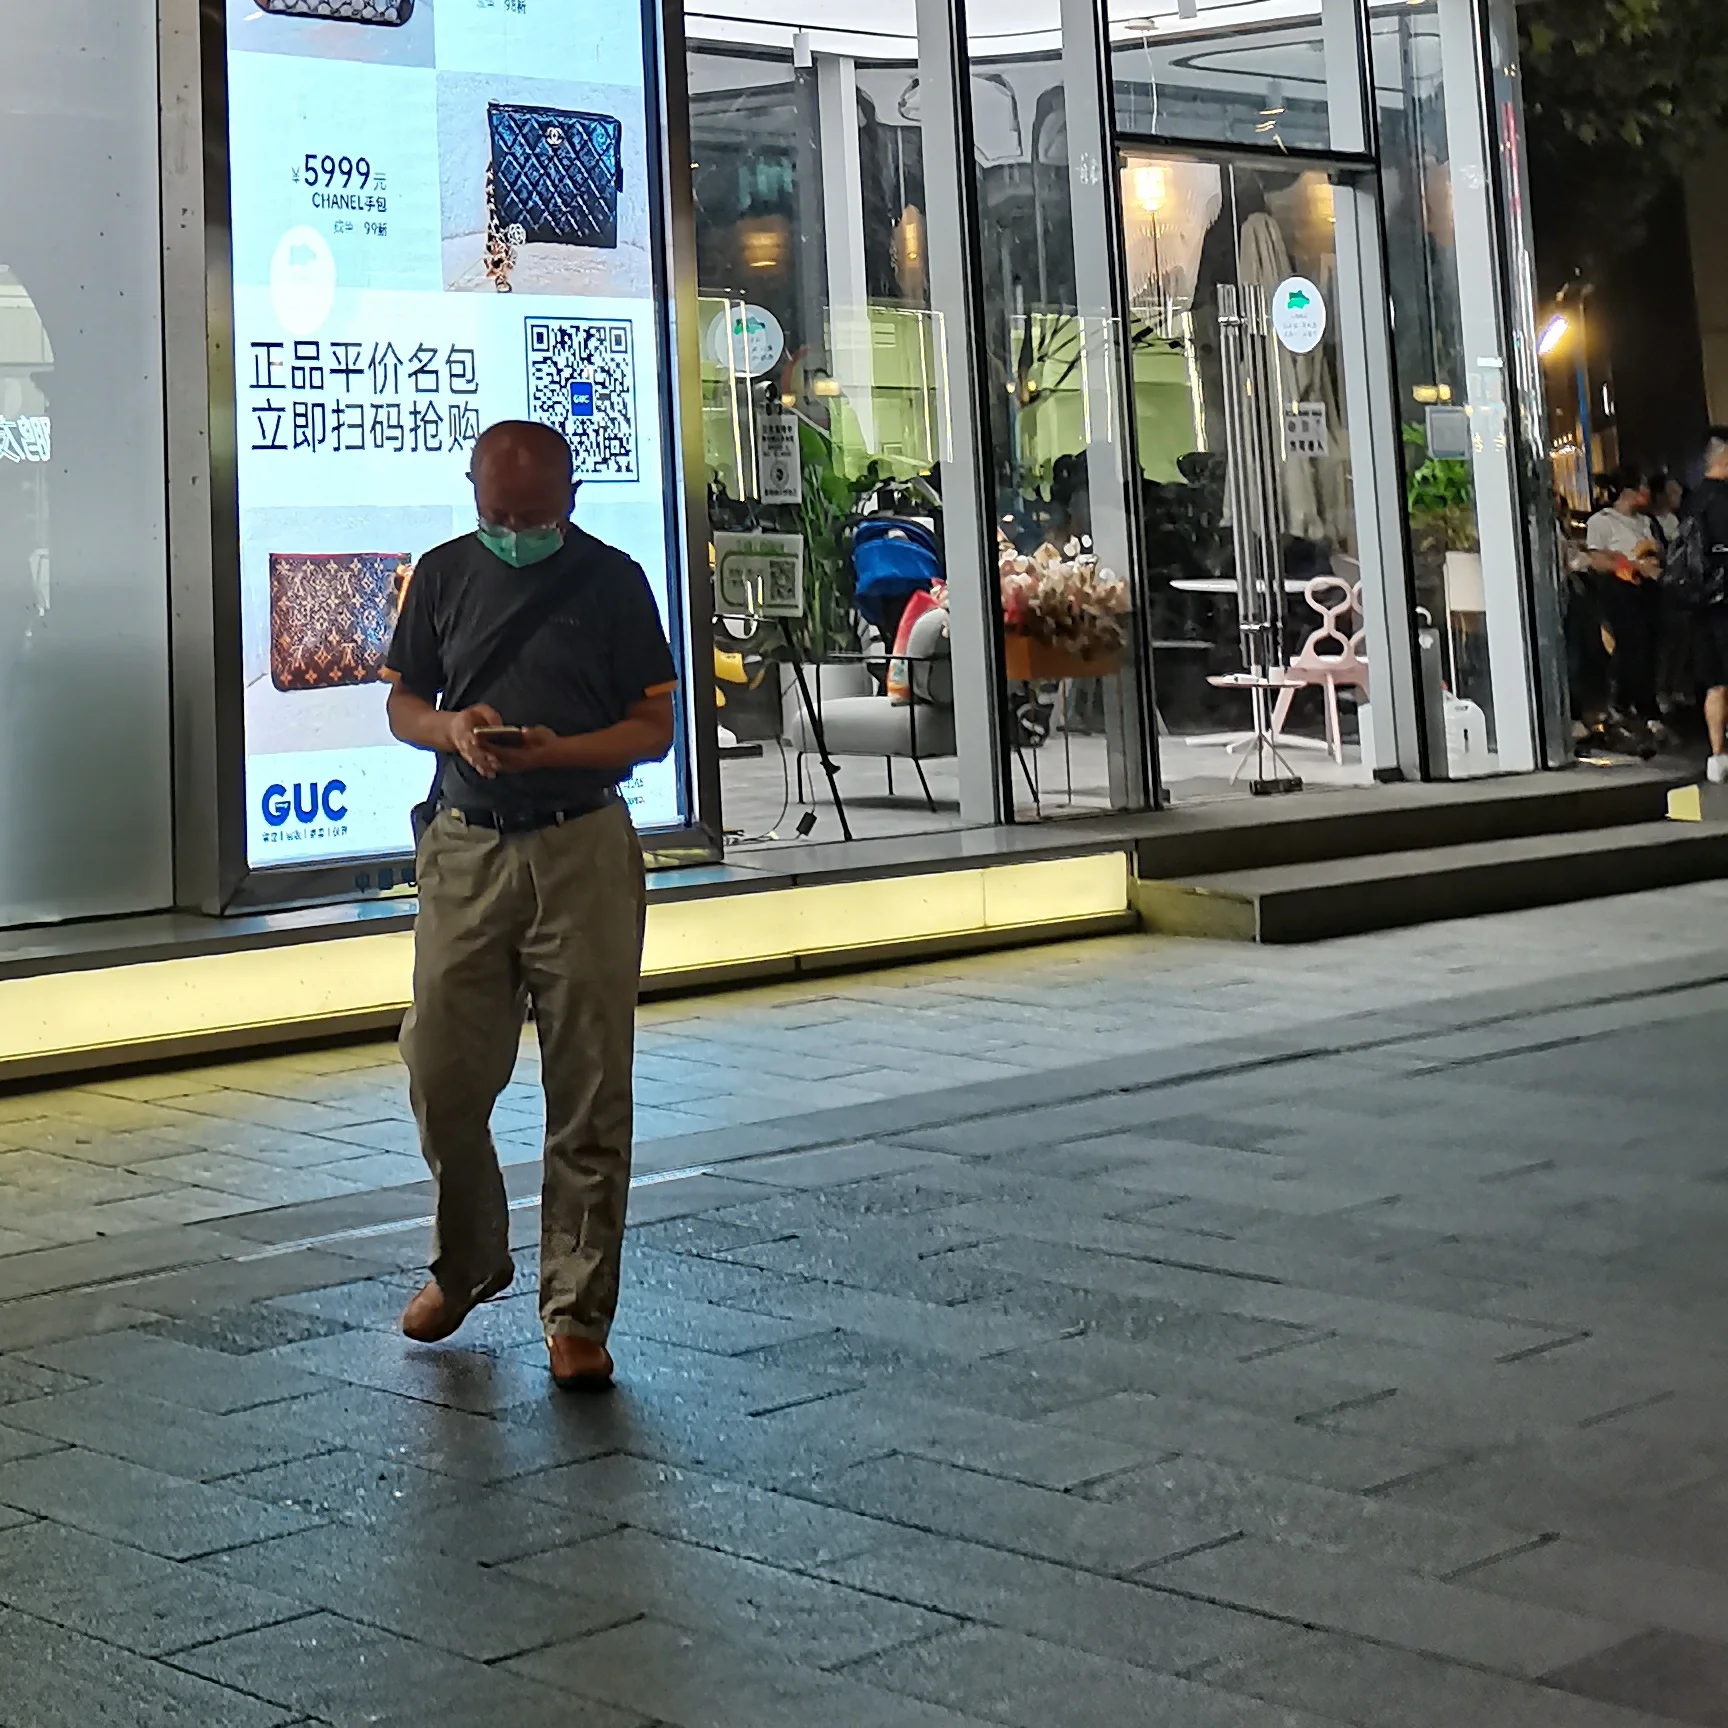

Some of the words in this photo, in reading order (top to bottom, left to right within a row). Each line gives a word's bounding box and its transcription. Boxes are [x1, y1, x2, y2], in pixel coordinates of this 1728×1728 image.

[311, 191, 387, 213] CHANEL手包
[249, 340, 479, 395] 正品平价名包
[251, 398, 479, 454] 立即扫码抢购
[261, 779, 348, 826] GUC
